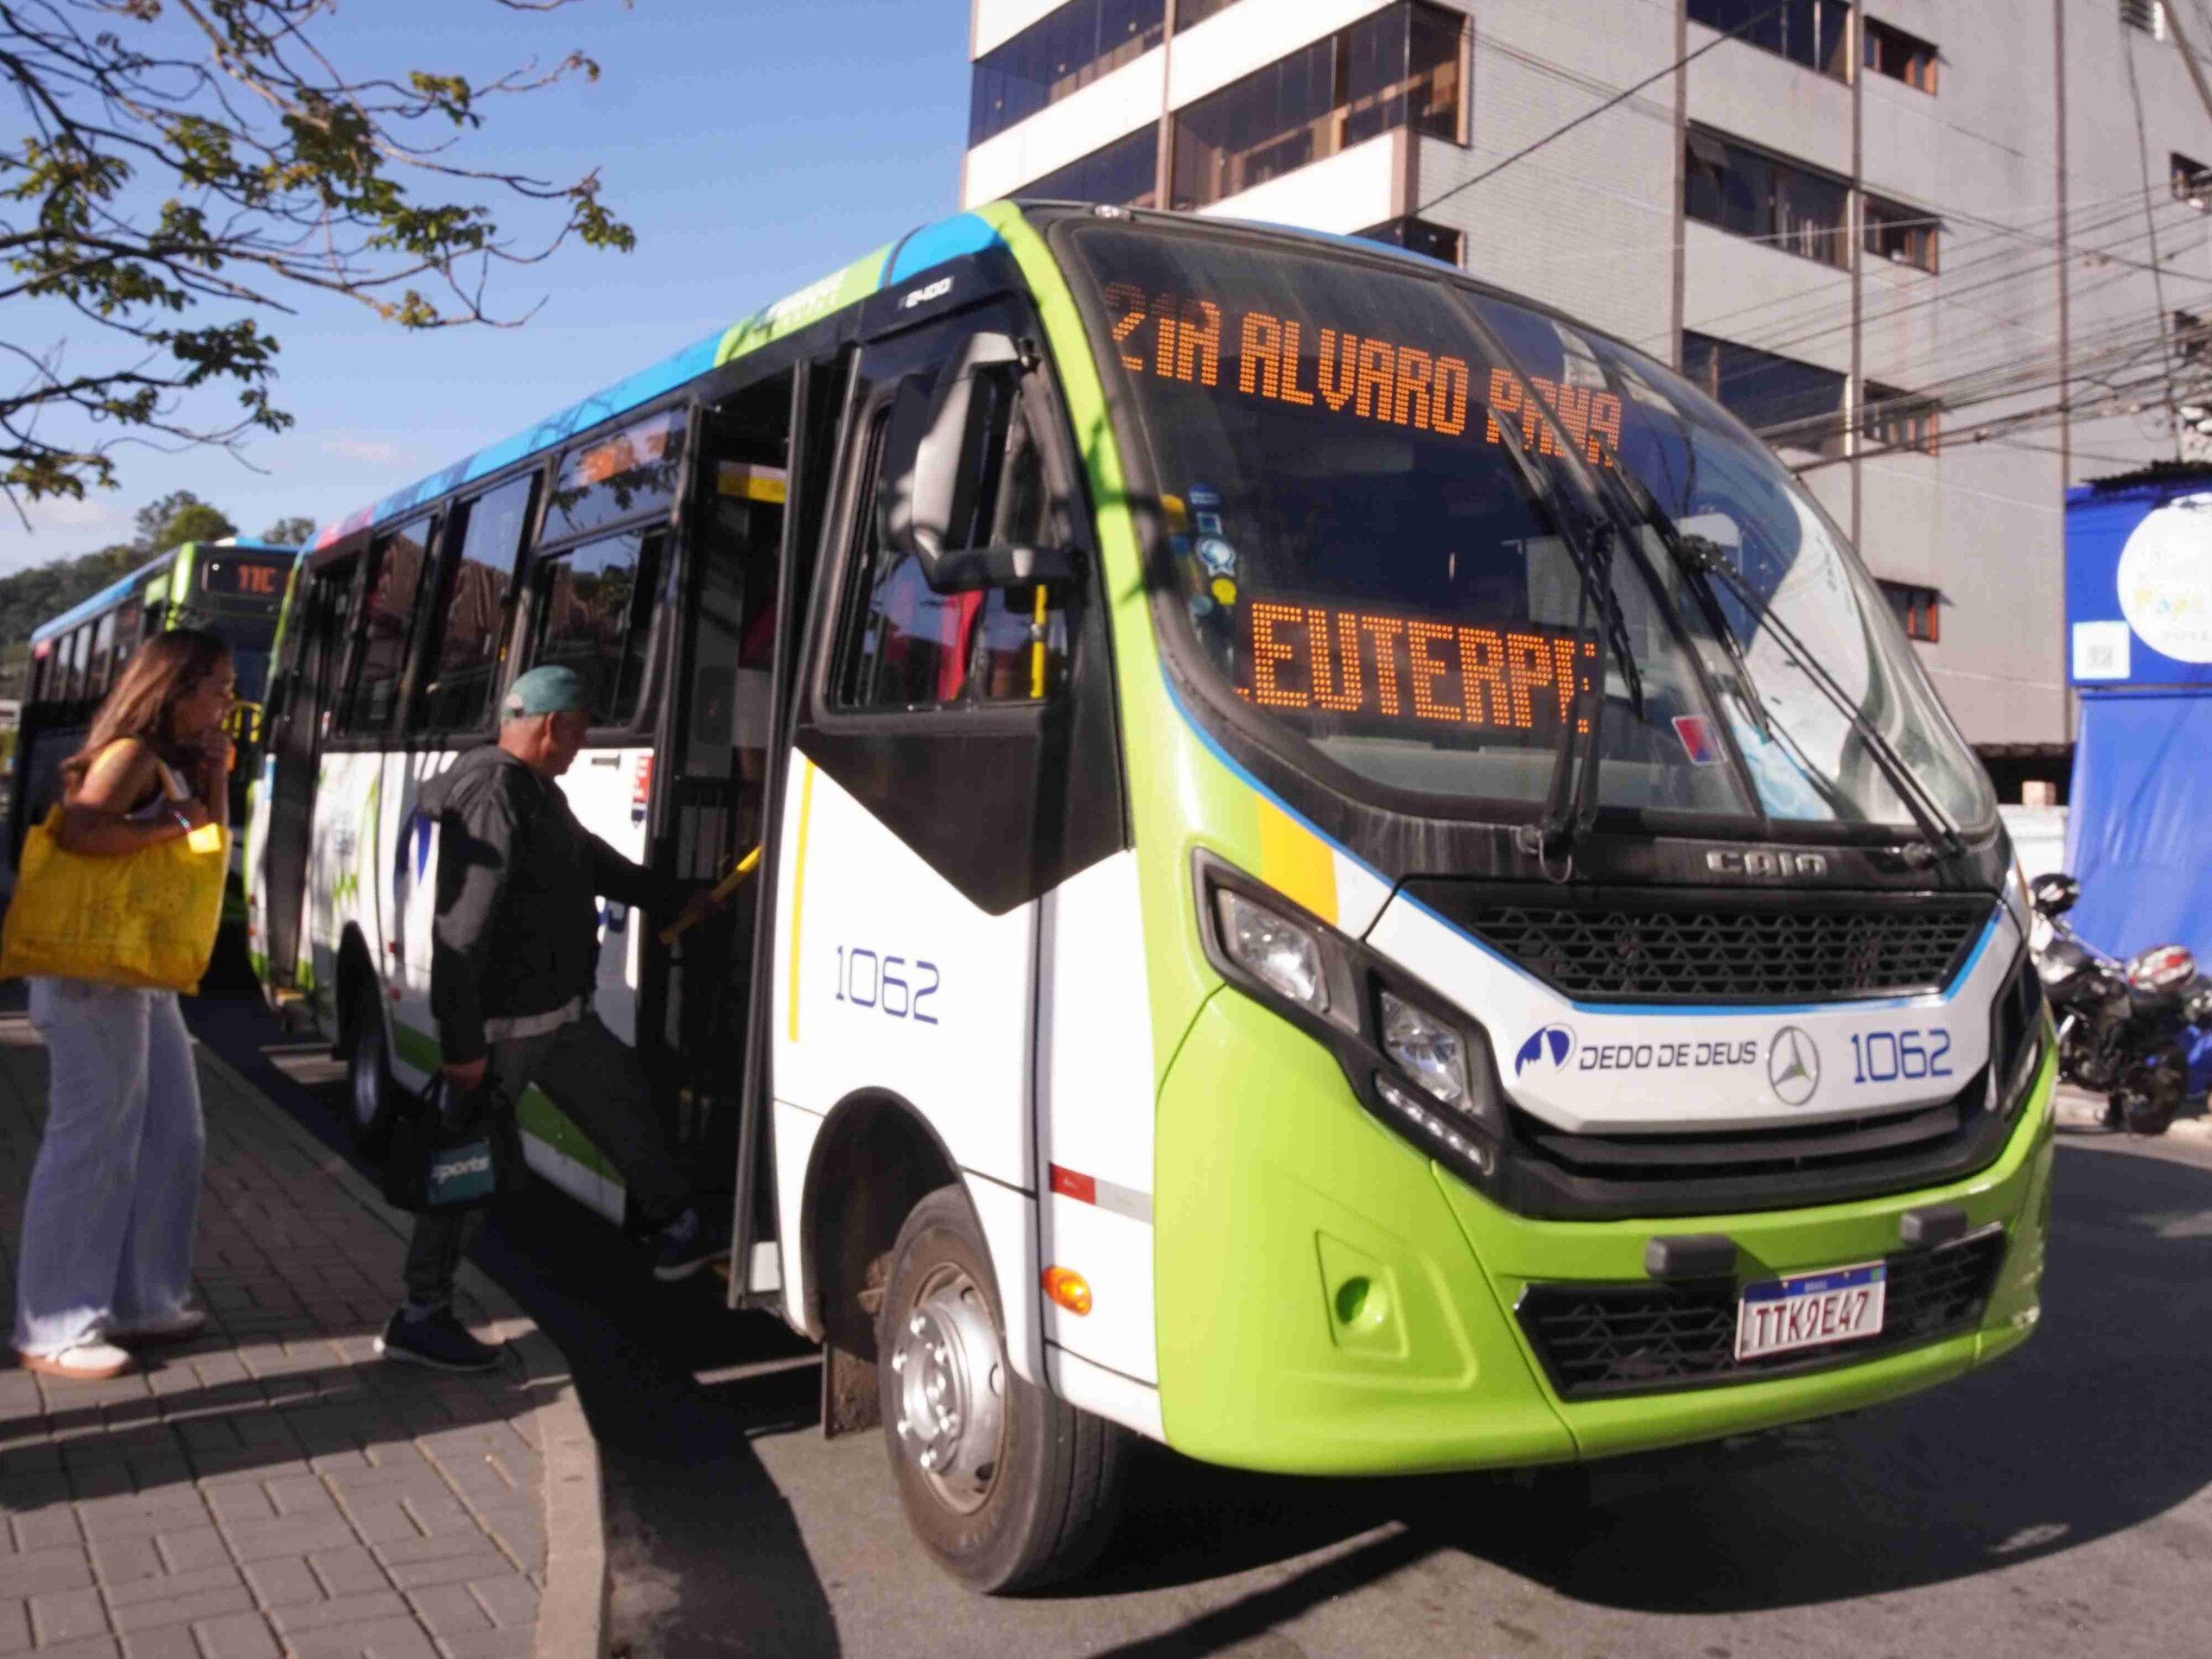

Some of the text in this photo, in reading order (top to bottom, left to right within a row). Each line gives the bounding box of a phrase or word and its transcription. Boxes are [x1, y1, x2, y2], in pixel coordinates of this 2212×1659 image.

[1239, 311, 1469, 435] ALVARO
[836, 945, 940, 1025] 1062
[1580, 1041, 1757, 1071] DEDO DE DEUS
[1851, 1027, 1953, 1084] 1062
[1752, 1290, 1869, 1349] TTK9E47
